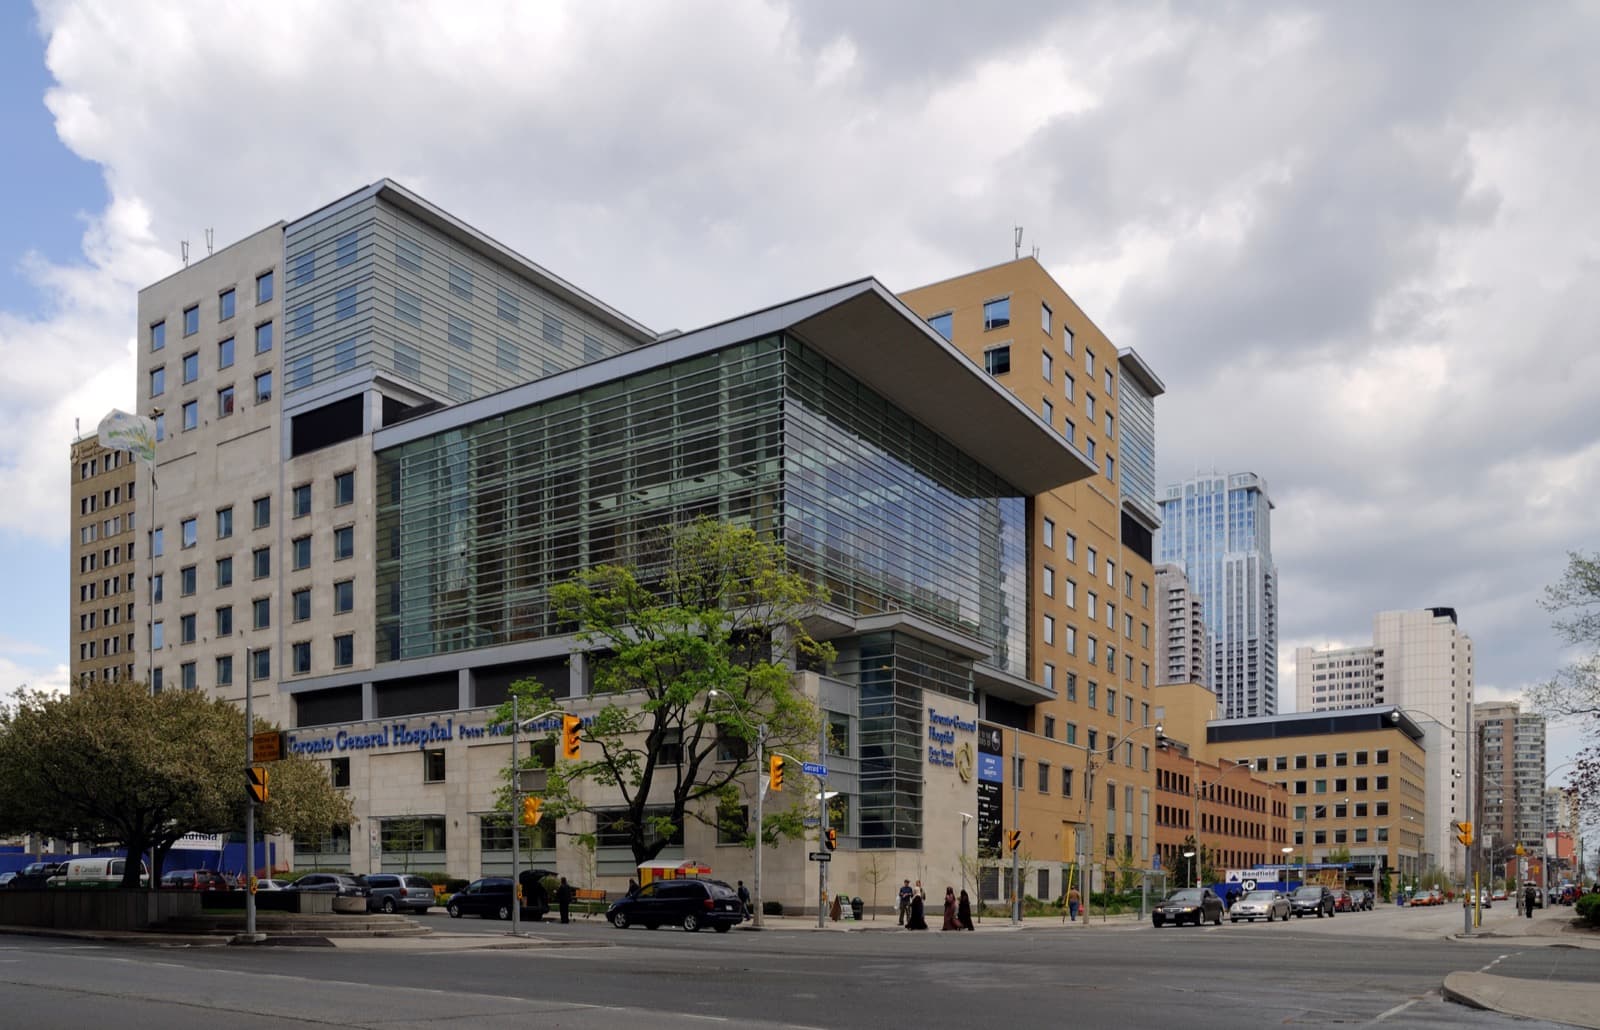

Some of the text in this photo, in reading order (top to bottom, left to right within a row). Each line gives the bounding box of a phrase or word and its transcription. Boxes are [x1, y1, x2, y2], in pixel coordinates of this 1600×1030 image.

[287, 735, 334, 754] Toronto
[336, 730, 388, 750] General
[392, 719, 453, 748] Hospital
[459, 723, 485, 740] Peter
